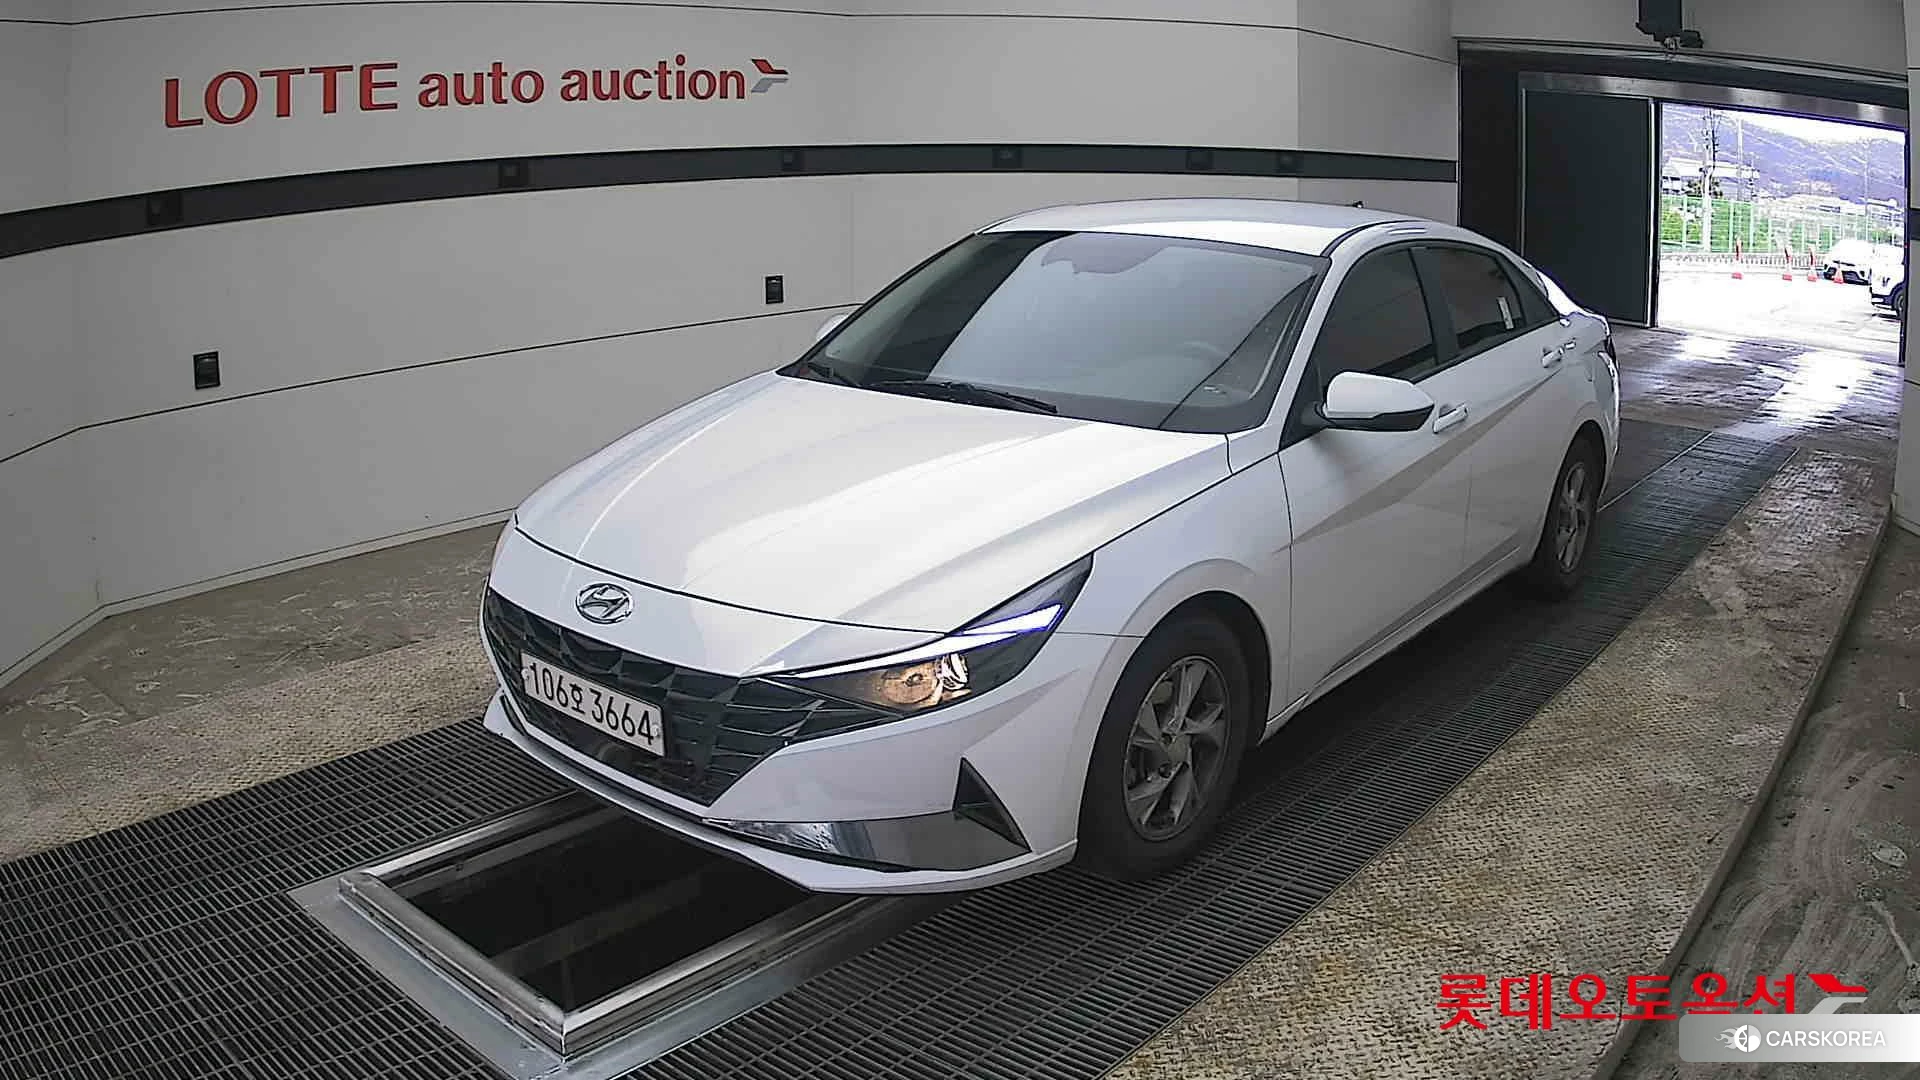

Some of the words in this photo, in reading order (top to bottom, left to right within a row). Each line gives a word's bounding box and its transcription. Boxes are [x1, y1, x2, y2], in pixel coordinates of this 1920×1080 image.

[164, 63, 399, 128] LOTTE
[418, 61, 544, 108] auto
[560, 54, 745, 102] auction
[530, 662, 585, 715] 106호
[590, 688, 655, 746] 3664
